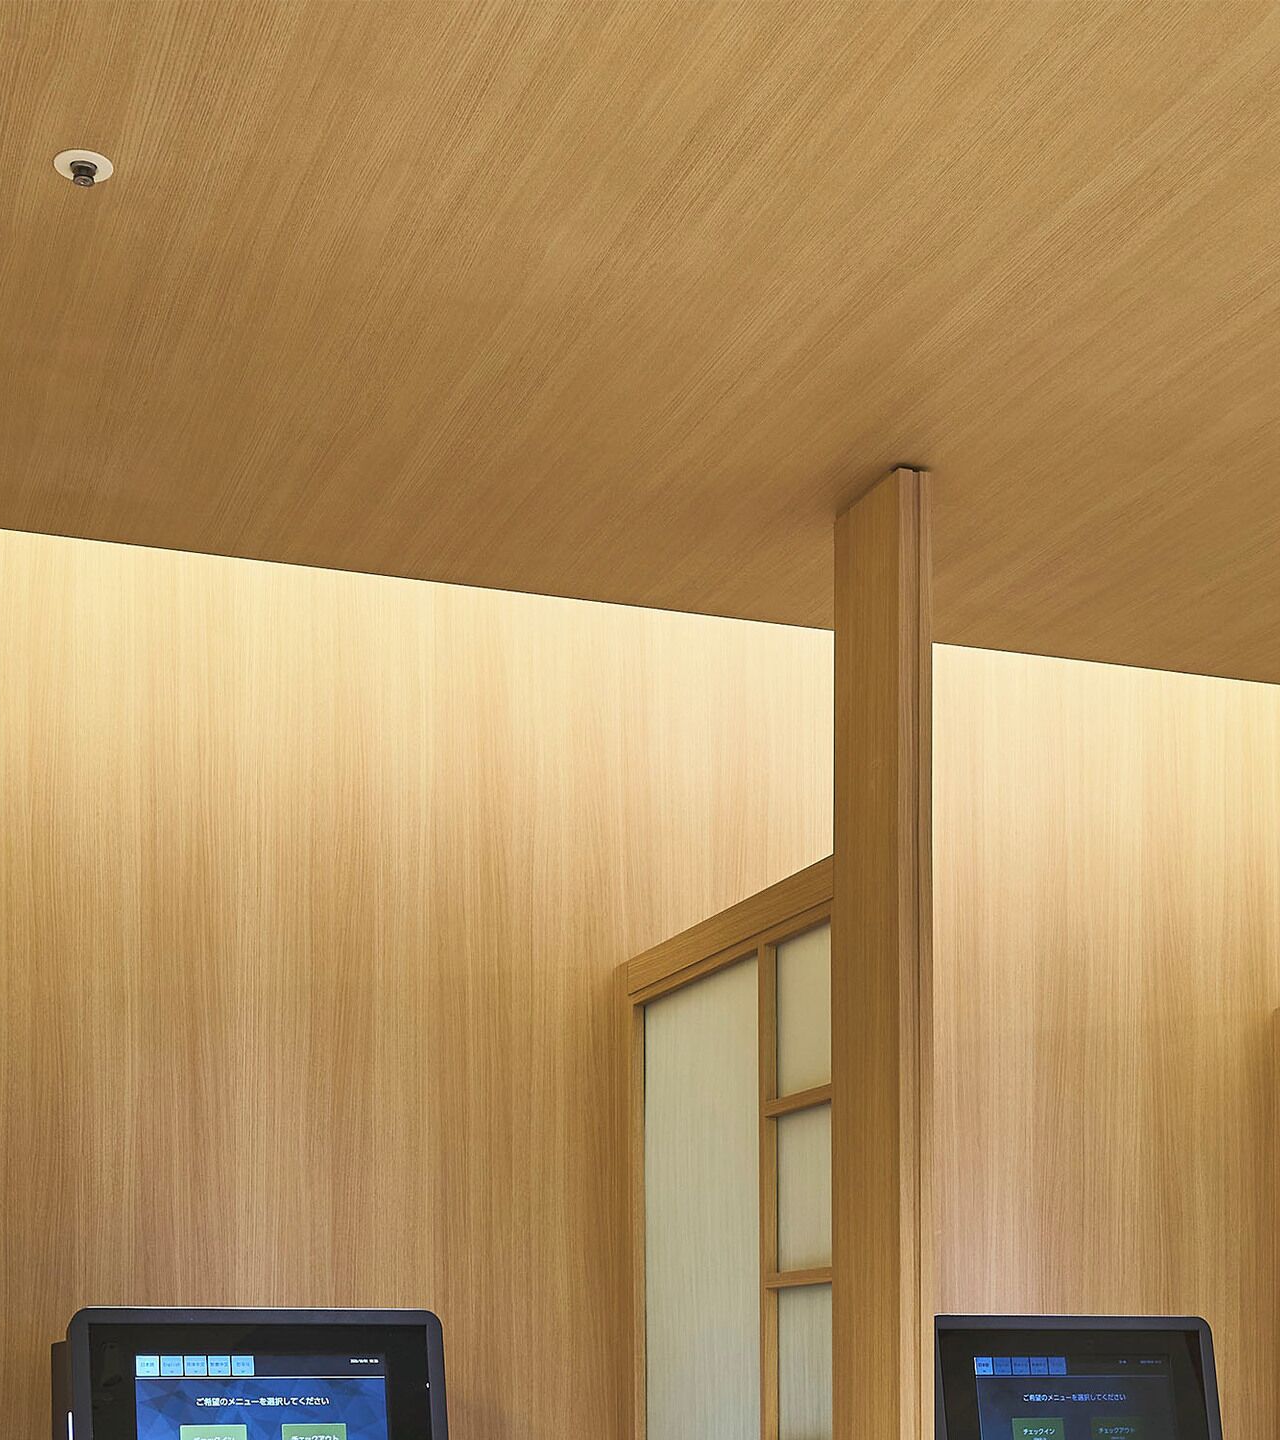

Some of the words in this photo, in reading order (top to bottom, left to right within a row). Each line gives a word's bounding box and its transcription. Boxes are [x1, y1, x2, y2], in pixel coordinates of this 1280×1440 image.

[195, 1396, 330, 1407] ご希望のメニューを選択してください
